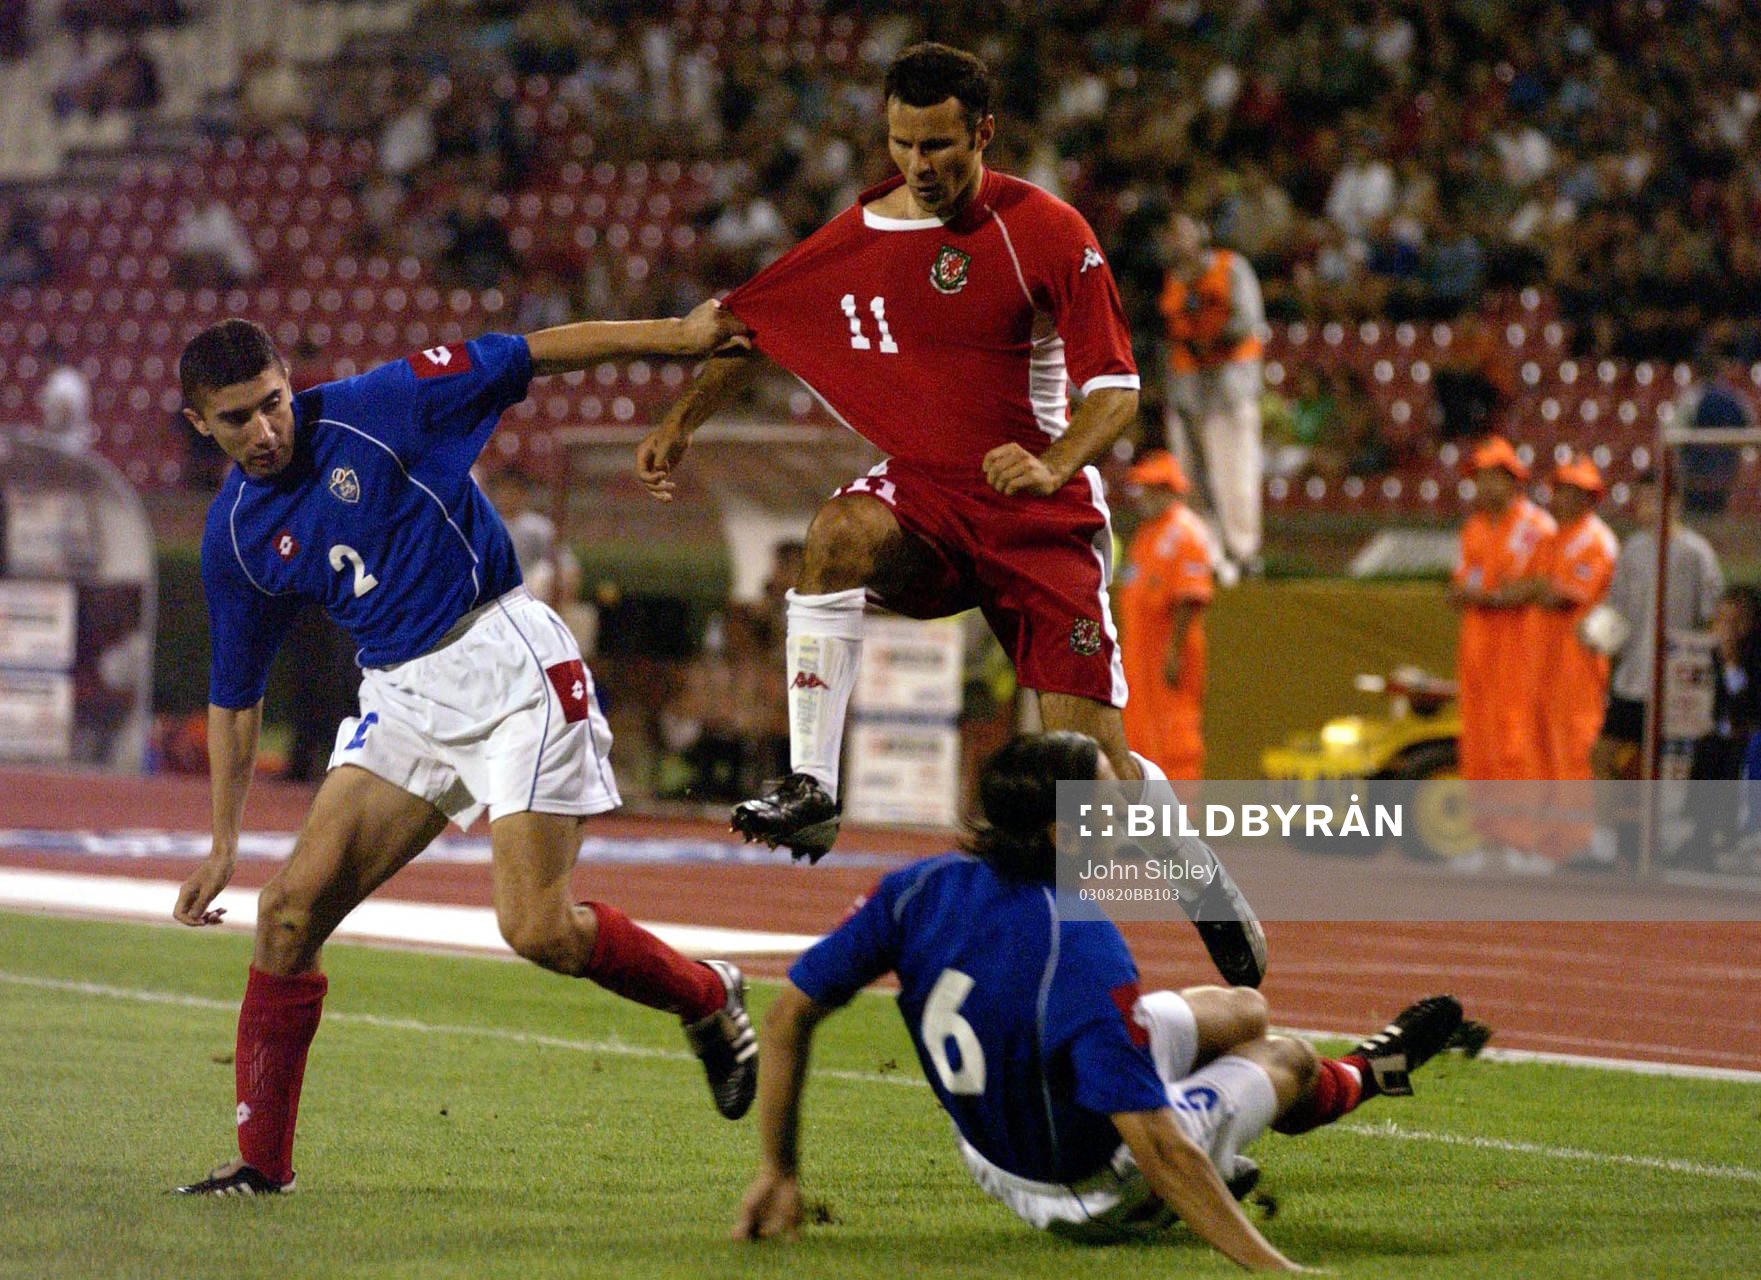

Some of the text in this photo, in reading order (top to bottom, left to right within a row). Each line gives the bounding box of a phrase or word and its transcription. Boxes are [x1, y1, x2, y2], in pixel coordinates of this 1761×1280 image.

[840, 293, 899, 354] 11
[328, 543, 379, 598] 2
[921, 968, 987, 1096] 6
